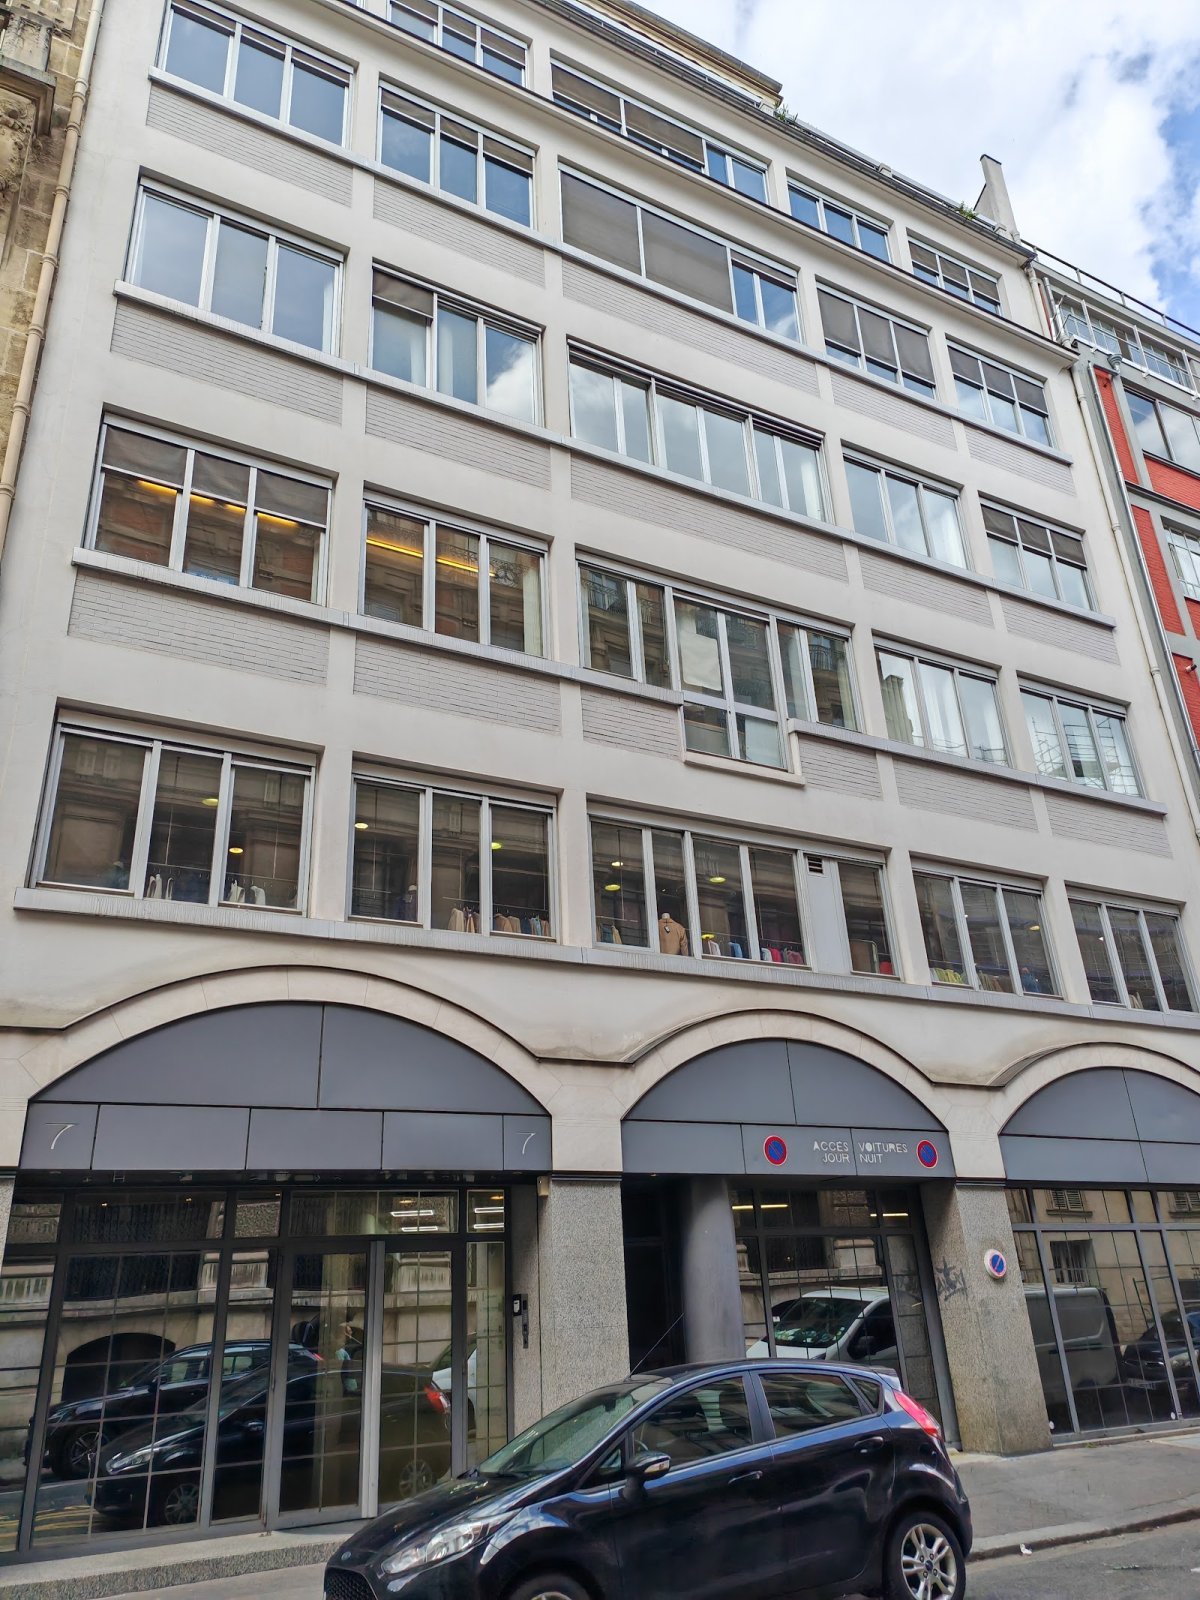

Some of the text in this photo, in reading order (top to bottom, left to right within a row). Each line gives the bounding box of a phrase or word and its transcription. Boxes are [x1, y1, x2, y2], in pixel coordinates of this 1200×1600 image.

[45, 1122, 76, 1150] 7
[515, 1131, 536, 1155] 7
[857, 1142, 908, 1153] VOITURES
[822, 1152, 884, 1164] JOUR NUIT
